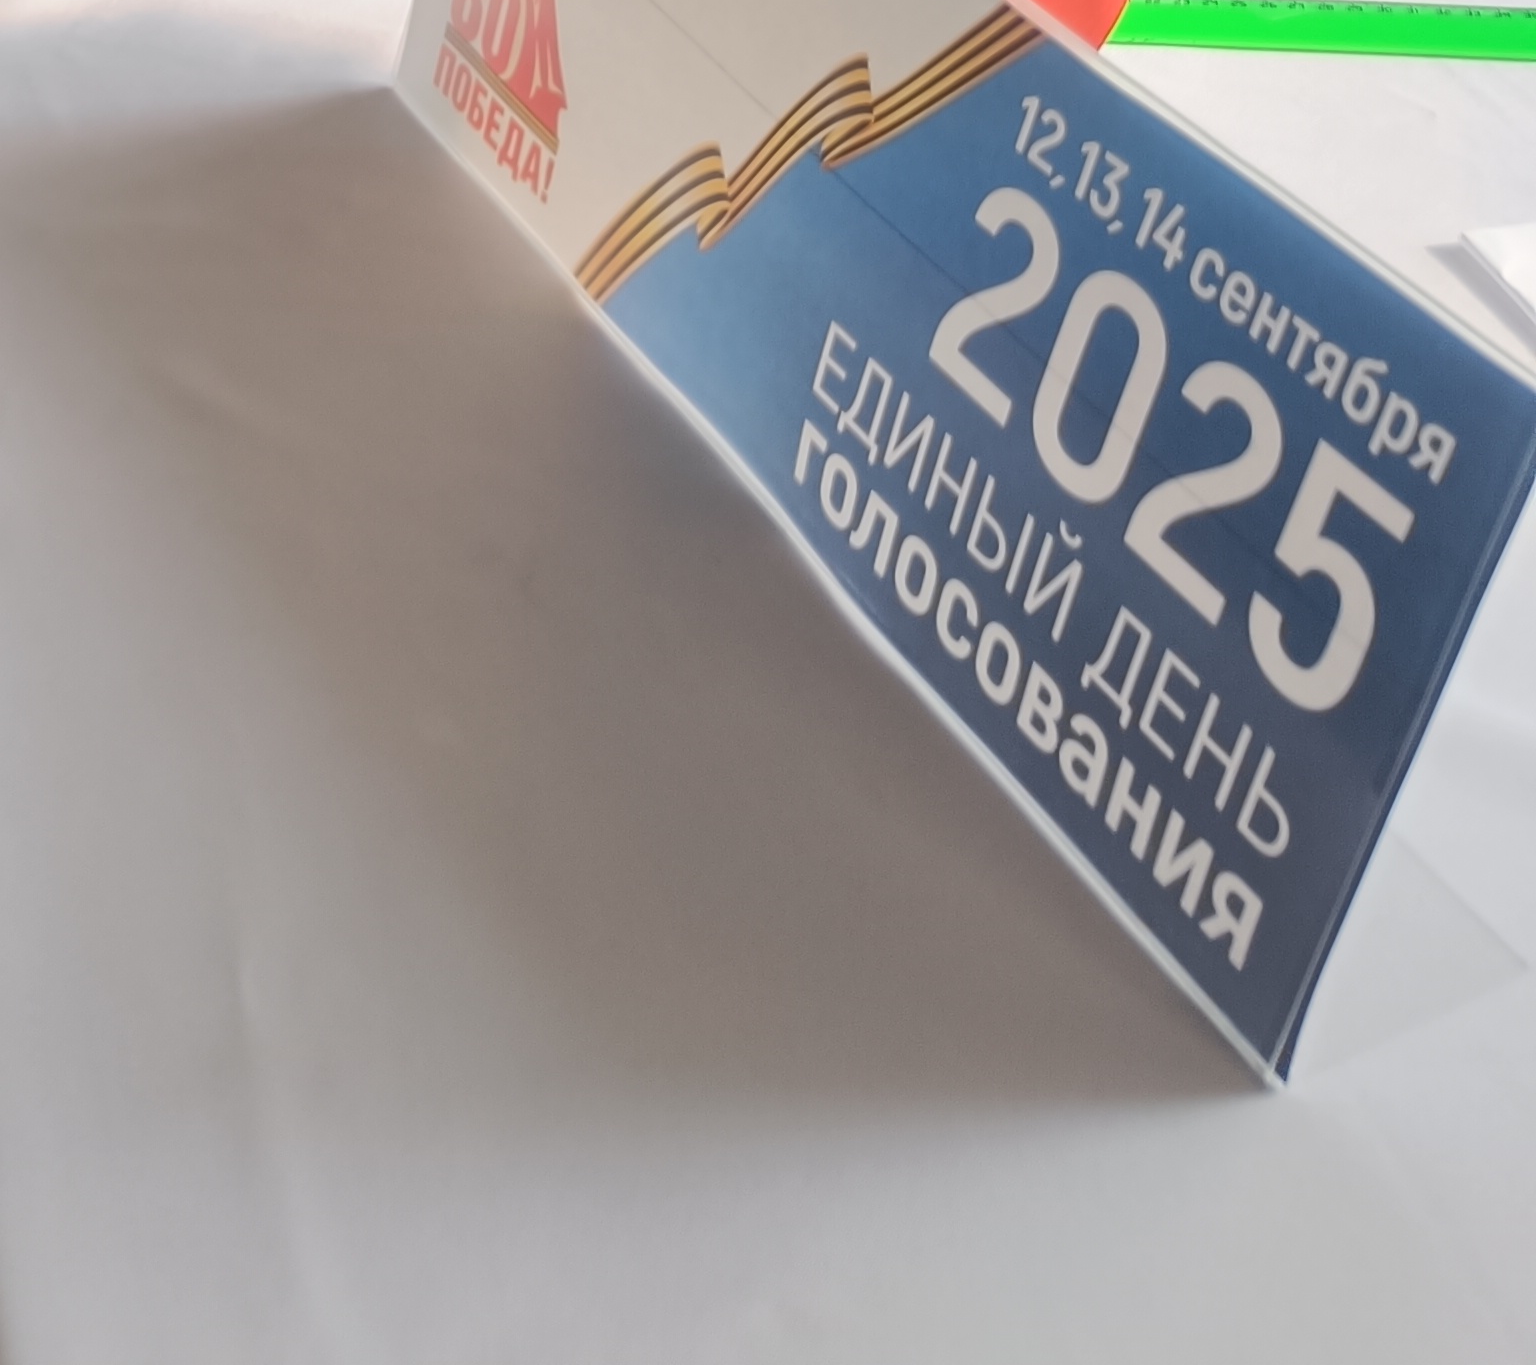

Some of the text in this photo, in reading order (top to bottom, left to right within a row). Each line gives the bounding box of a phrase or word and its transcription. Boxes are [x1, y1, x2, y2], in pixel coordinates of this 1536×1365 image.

[432, 42, 556, 204] ПОБЕДА!
[1189, 248, 1457, 485] сентября
[794, 418, 1263, 971] голосования
[812, 320, 1290, 858] ЕДИНЫЙ ДЕНЬ
[928, 186, 1415, 711] 2025
